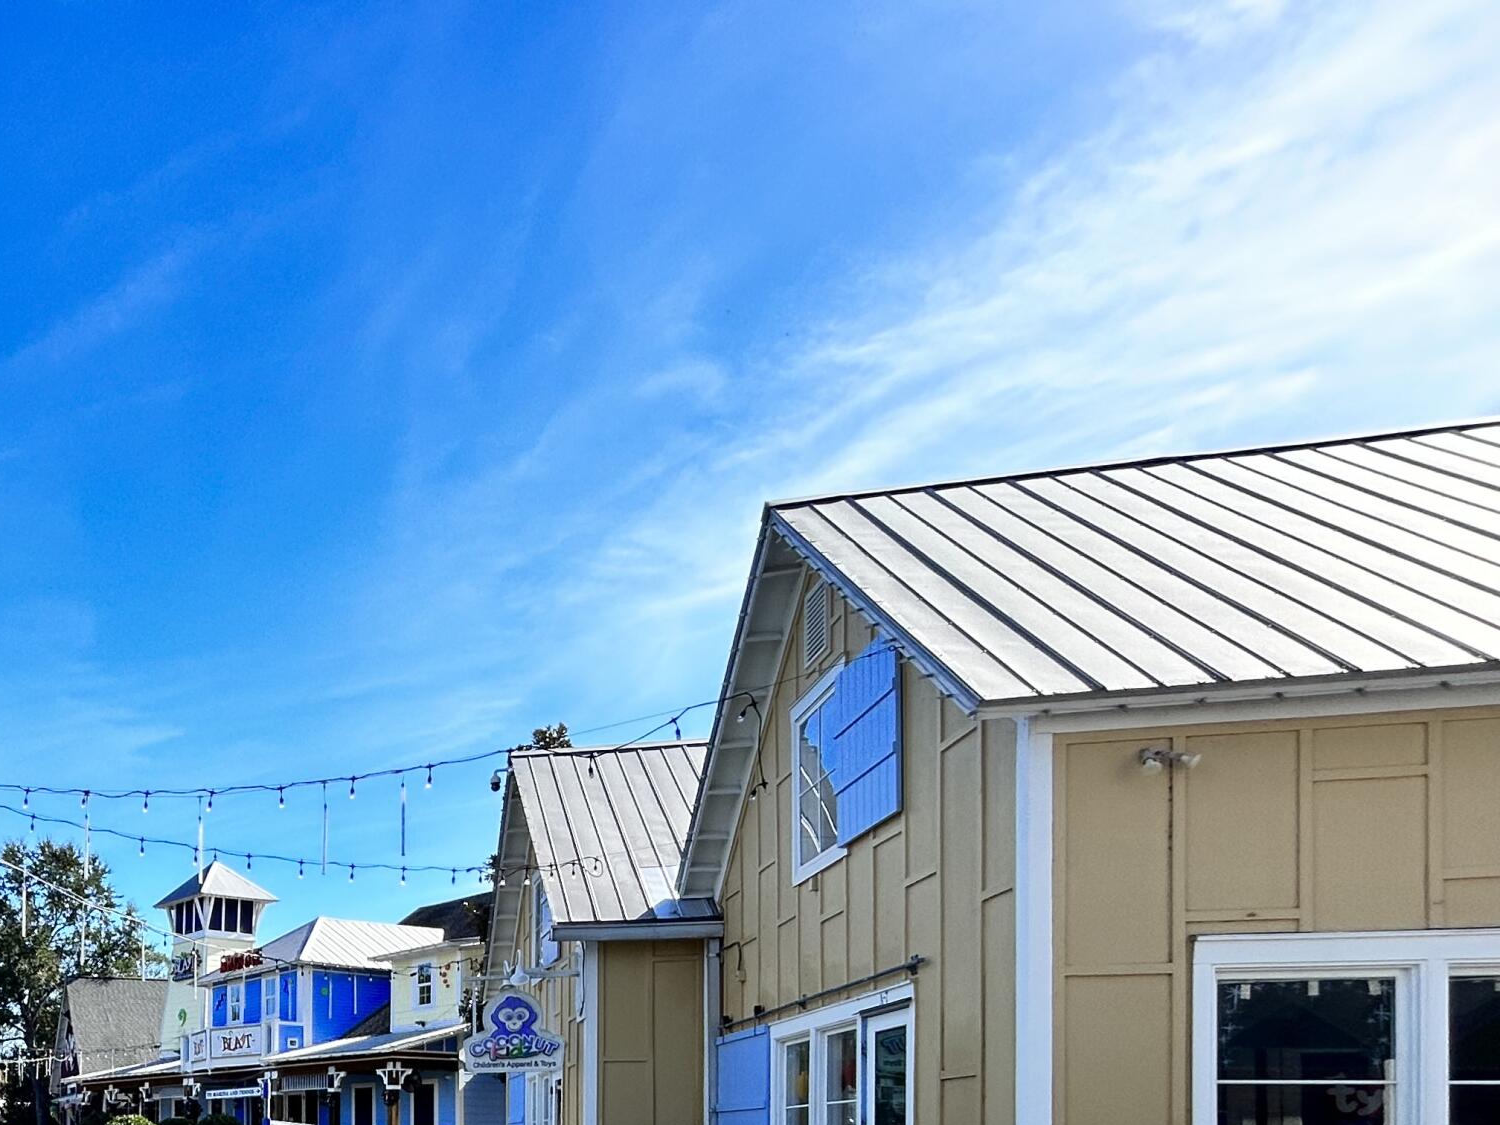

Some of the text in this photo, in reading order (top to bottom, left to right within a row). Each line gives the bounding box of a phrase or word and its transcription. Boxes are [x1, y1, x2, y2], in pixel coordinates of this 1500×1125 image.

[469, 1034, 560, 1058] COCONUT
[472, 1061, 505, 1069] Children's
[506, 1060, 533, 1069] Apparel
[540, 1060, 557, 1068] Toys
